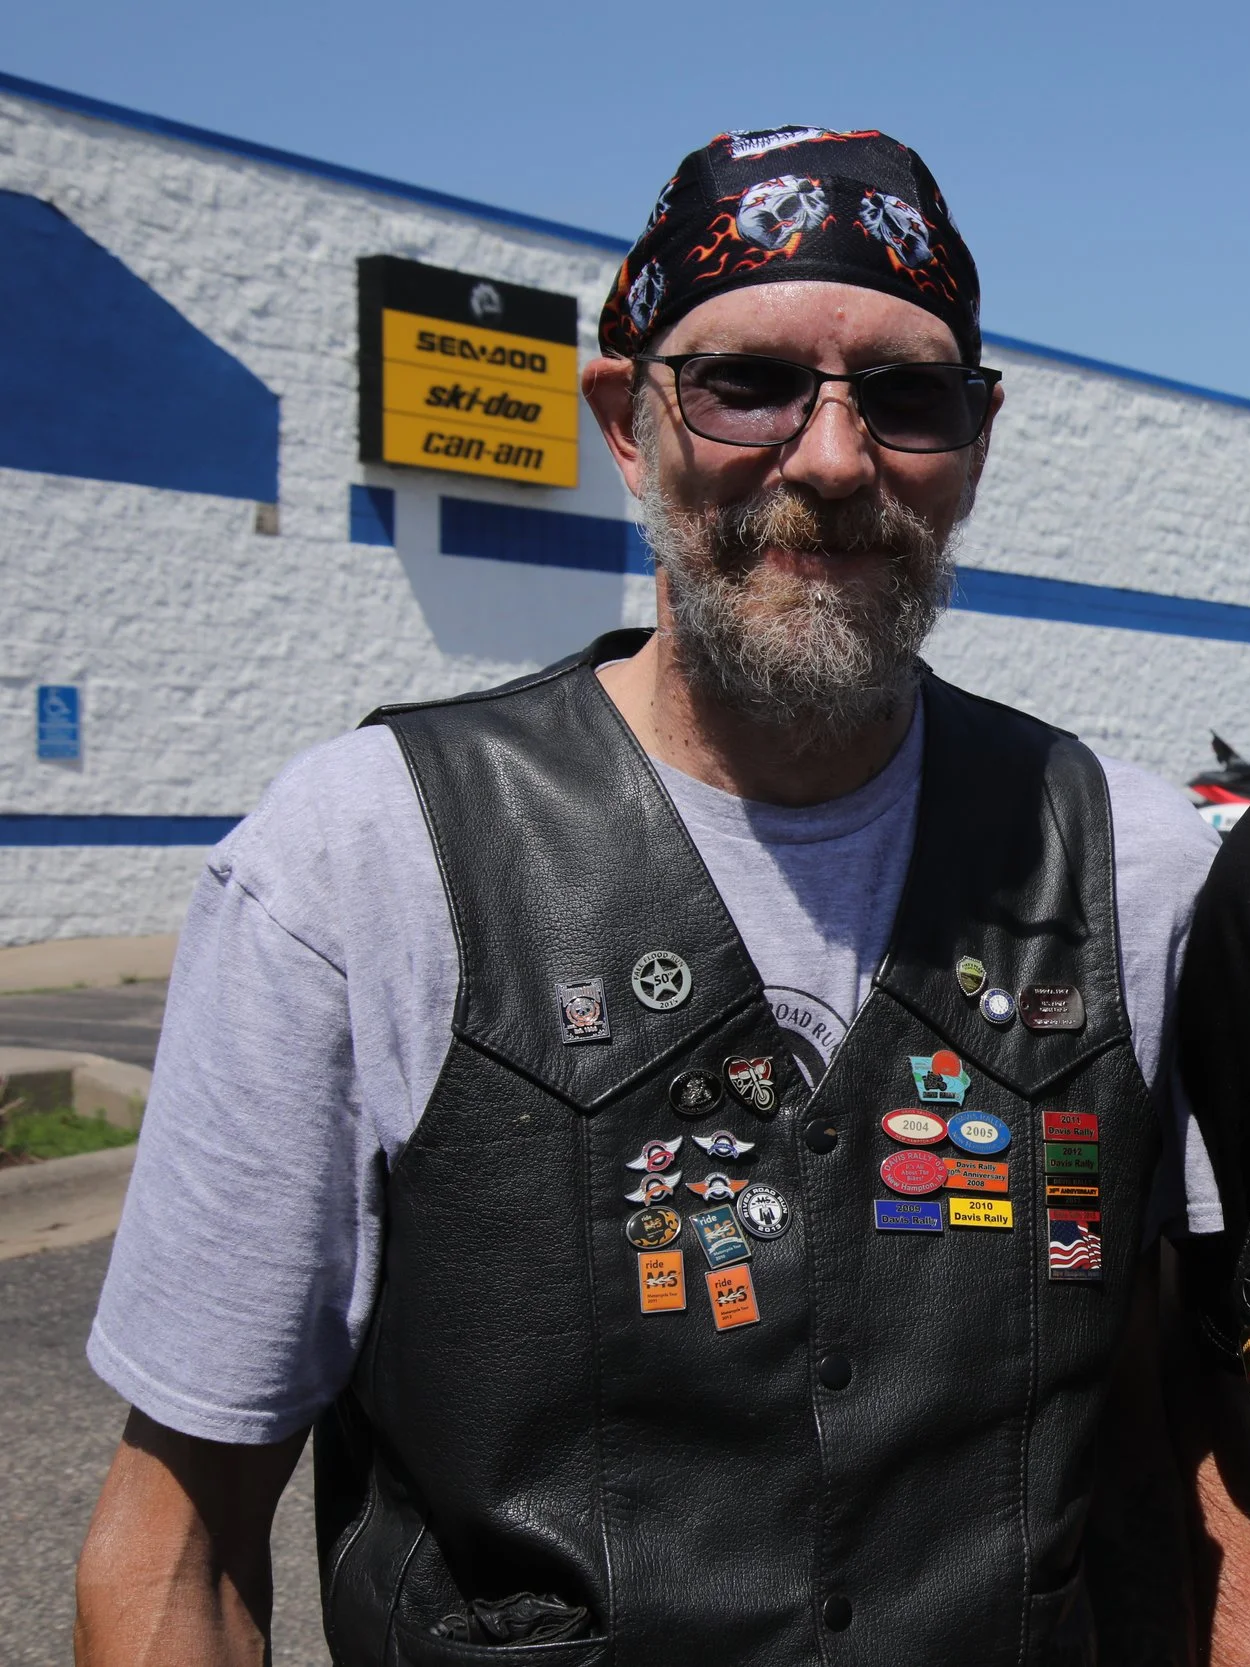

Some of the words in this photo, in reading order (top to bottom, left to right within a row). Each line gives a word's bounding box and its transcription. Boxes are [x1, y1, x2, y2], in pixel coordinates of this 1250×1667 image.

[425, 383, 542, 423] ski-doo
[422, 432, 544, 471] can-am
[633, 961, 644, 980] FALL
[644, 951, 669, 964] FLOOD
[670, 954, 685, 967] RUN
[769, 1003, 813, 1028] OAD
[1061, 1115, 1081, 1124] 2011
[902, 1120, 929, 1132] 2004
[966, 1126, 993, 1138] 2005
[1048, 1126, 1072, 1136] Davis
[1073, 1127, 1095, 1138] Rally
[884, 1152, 906, 1172] DAVIS
[907, 1152, 933, 1161] RALLY
[956, 1161, 977, 1169] Davis
[978, 1163, 996, 1171] Rally
[1050, 1159, 1073, 1168] Davis
[1074, 1159, 1095, 1170] Rally
[886, 1174, 900, 1188] New
[962, 1170, 1006, 1181] Anniversary
[743, 1191, 752, 1219] RIVER
[752, 1187, 777, 1196] ROAD
[776, 1195, 788, 1214] RUN
[969, 1202, 993, 1210] 2010
[699, 1215, 717, 1226] ride
[881, 1215, 910, 1224] Davis
[912, 1216, 938, 1227] Rally
[954, 1213, 982, 1222] Davis
[984, 1213, 1009, 1225] Rally
[645, 1260, 664, 1269] ride
[715, 1278, 732, 1289] ride
